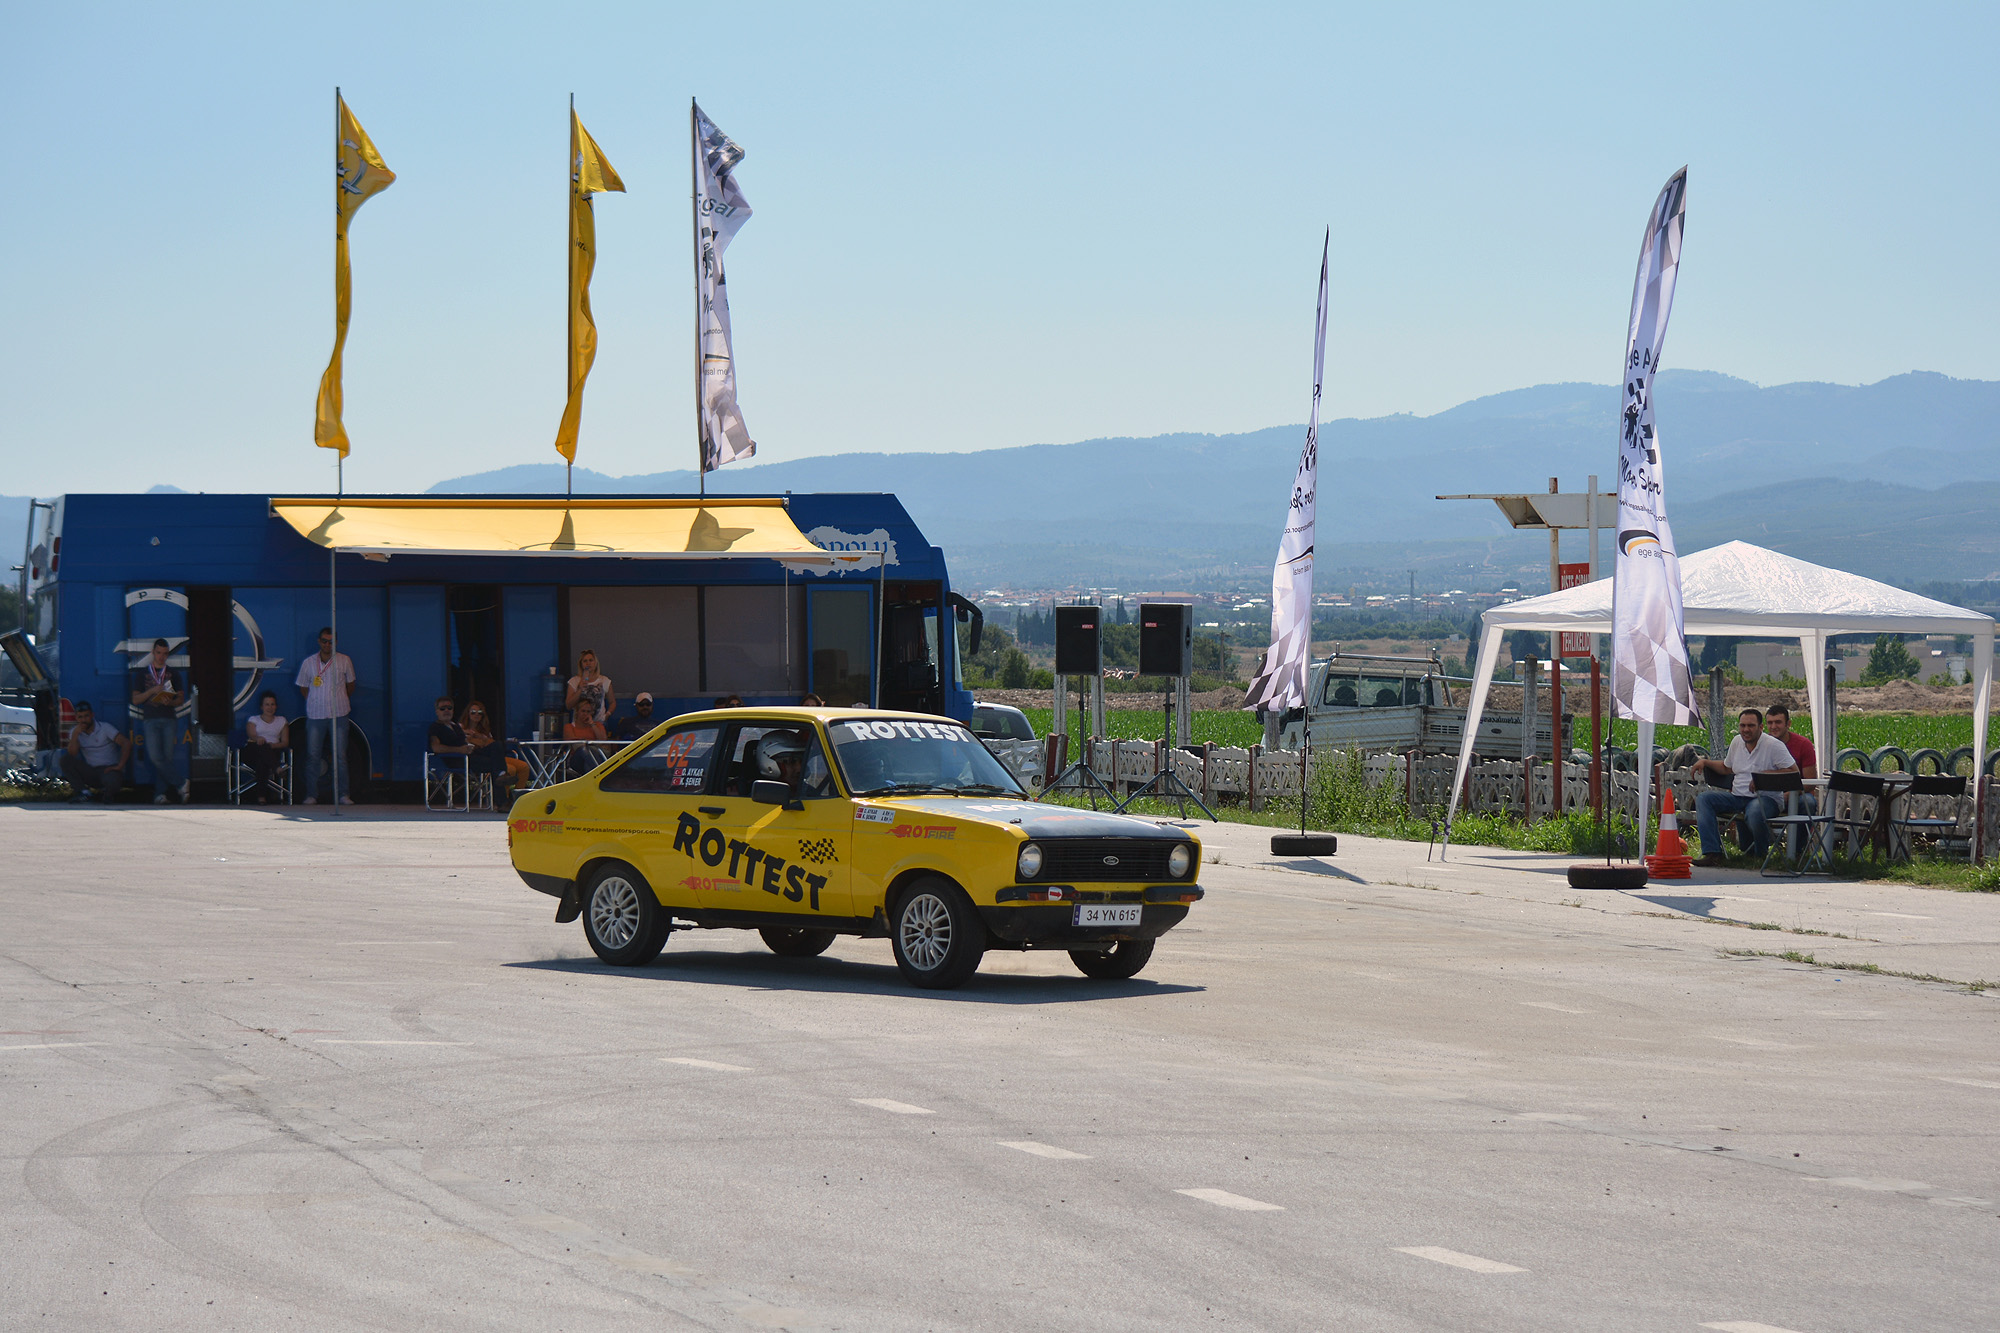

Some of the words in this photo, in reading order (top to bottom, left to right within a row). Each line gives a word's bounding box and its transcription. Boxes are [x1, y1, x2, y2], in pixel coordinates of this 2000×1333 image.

[1638, 549, 1652, 558] ege
[844, 721, 970, 743] ROTTEST
[667, 733, 696, 769] 62
[566, 825, 660, 834] www.egeasalmotorspor.com
[927, 830, 956, 839] FIRE
[673, 811, 828, 911] ROTTEST
[716, 883, 741, 892] FIRE
[1086, 910, 1099, 921] 34
[1102, 910, 1117, 921] YN
[1119, 910, 1136, 921] 615
